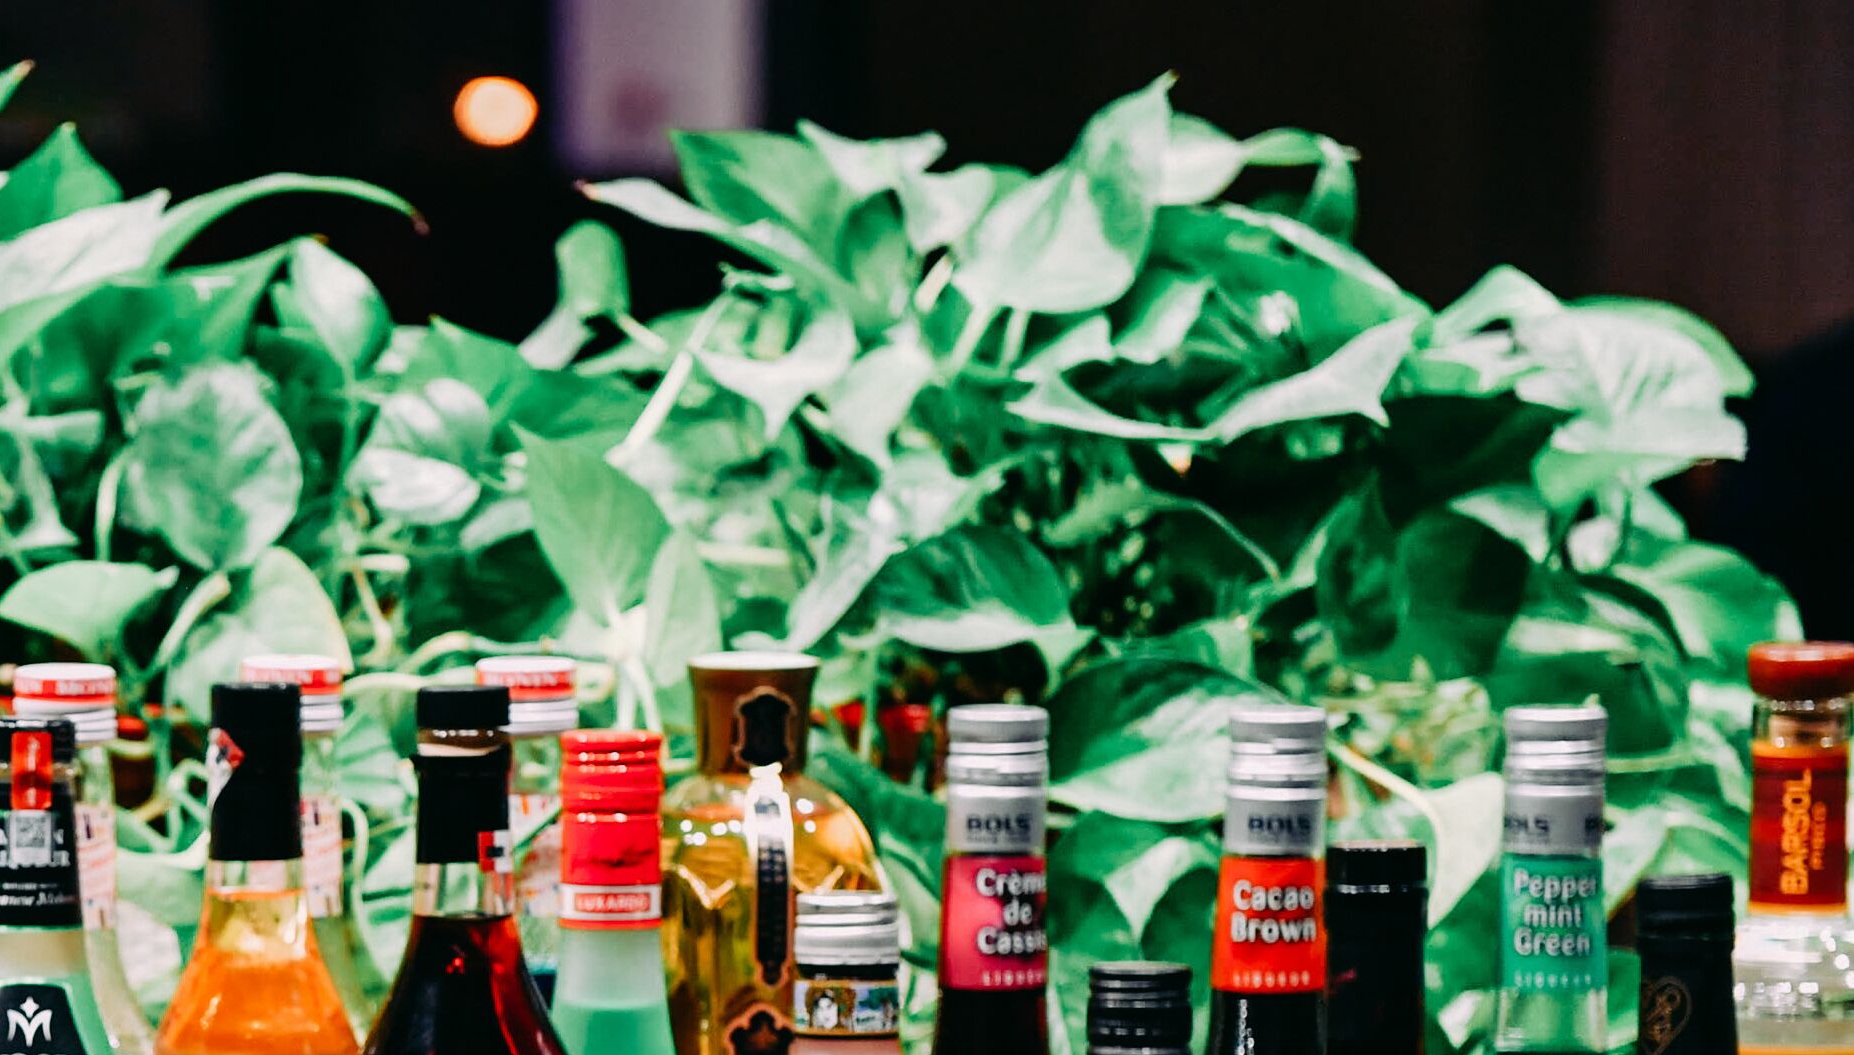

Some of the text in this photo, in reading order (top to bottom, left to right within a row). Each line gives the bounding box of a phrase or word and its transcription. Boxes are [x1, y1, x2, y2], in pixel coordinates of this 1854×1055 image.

[1233, 880, 1314, 912] Cacao
[1003, 900, 1033, 925] de
[1524, 901, 1581, 928] mint
[1231, 912, 1317, 945] Brown
[1514, 928, 1591, 957] Green
